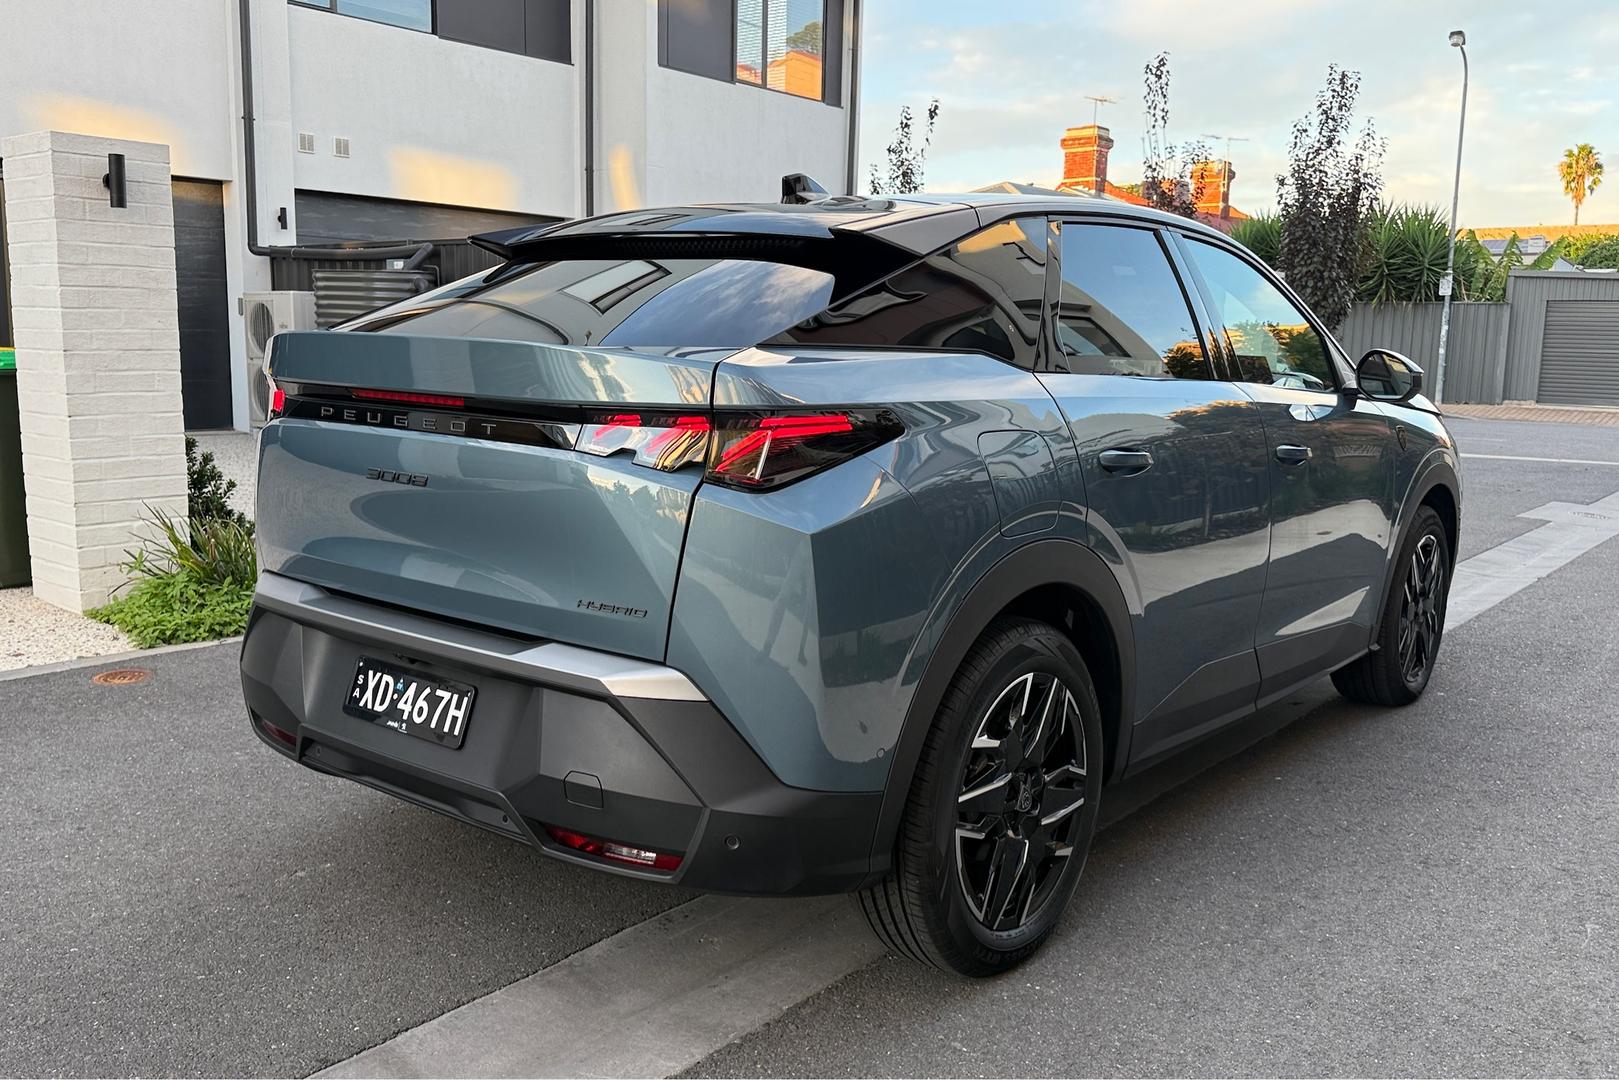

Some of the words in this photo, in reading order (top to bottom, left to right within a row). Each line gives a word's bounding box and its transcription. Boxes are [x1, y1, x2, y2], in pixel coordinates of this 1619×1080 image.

[321, 406, 496, 435] PEUGEOT
[366, 467, 428, 487] 3008
[577, 599, 648, 618] HYBRID
